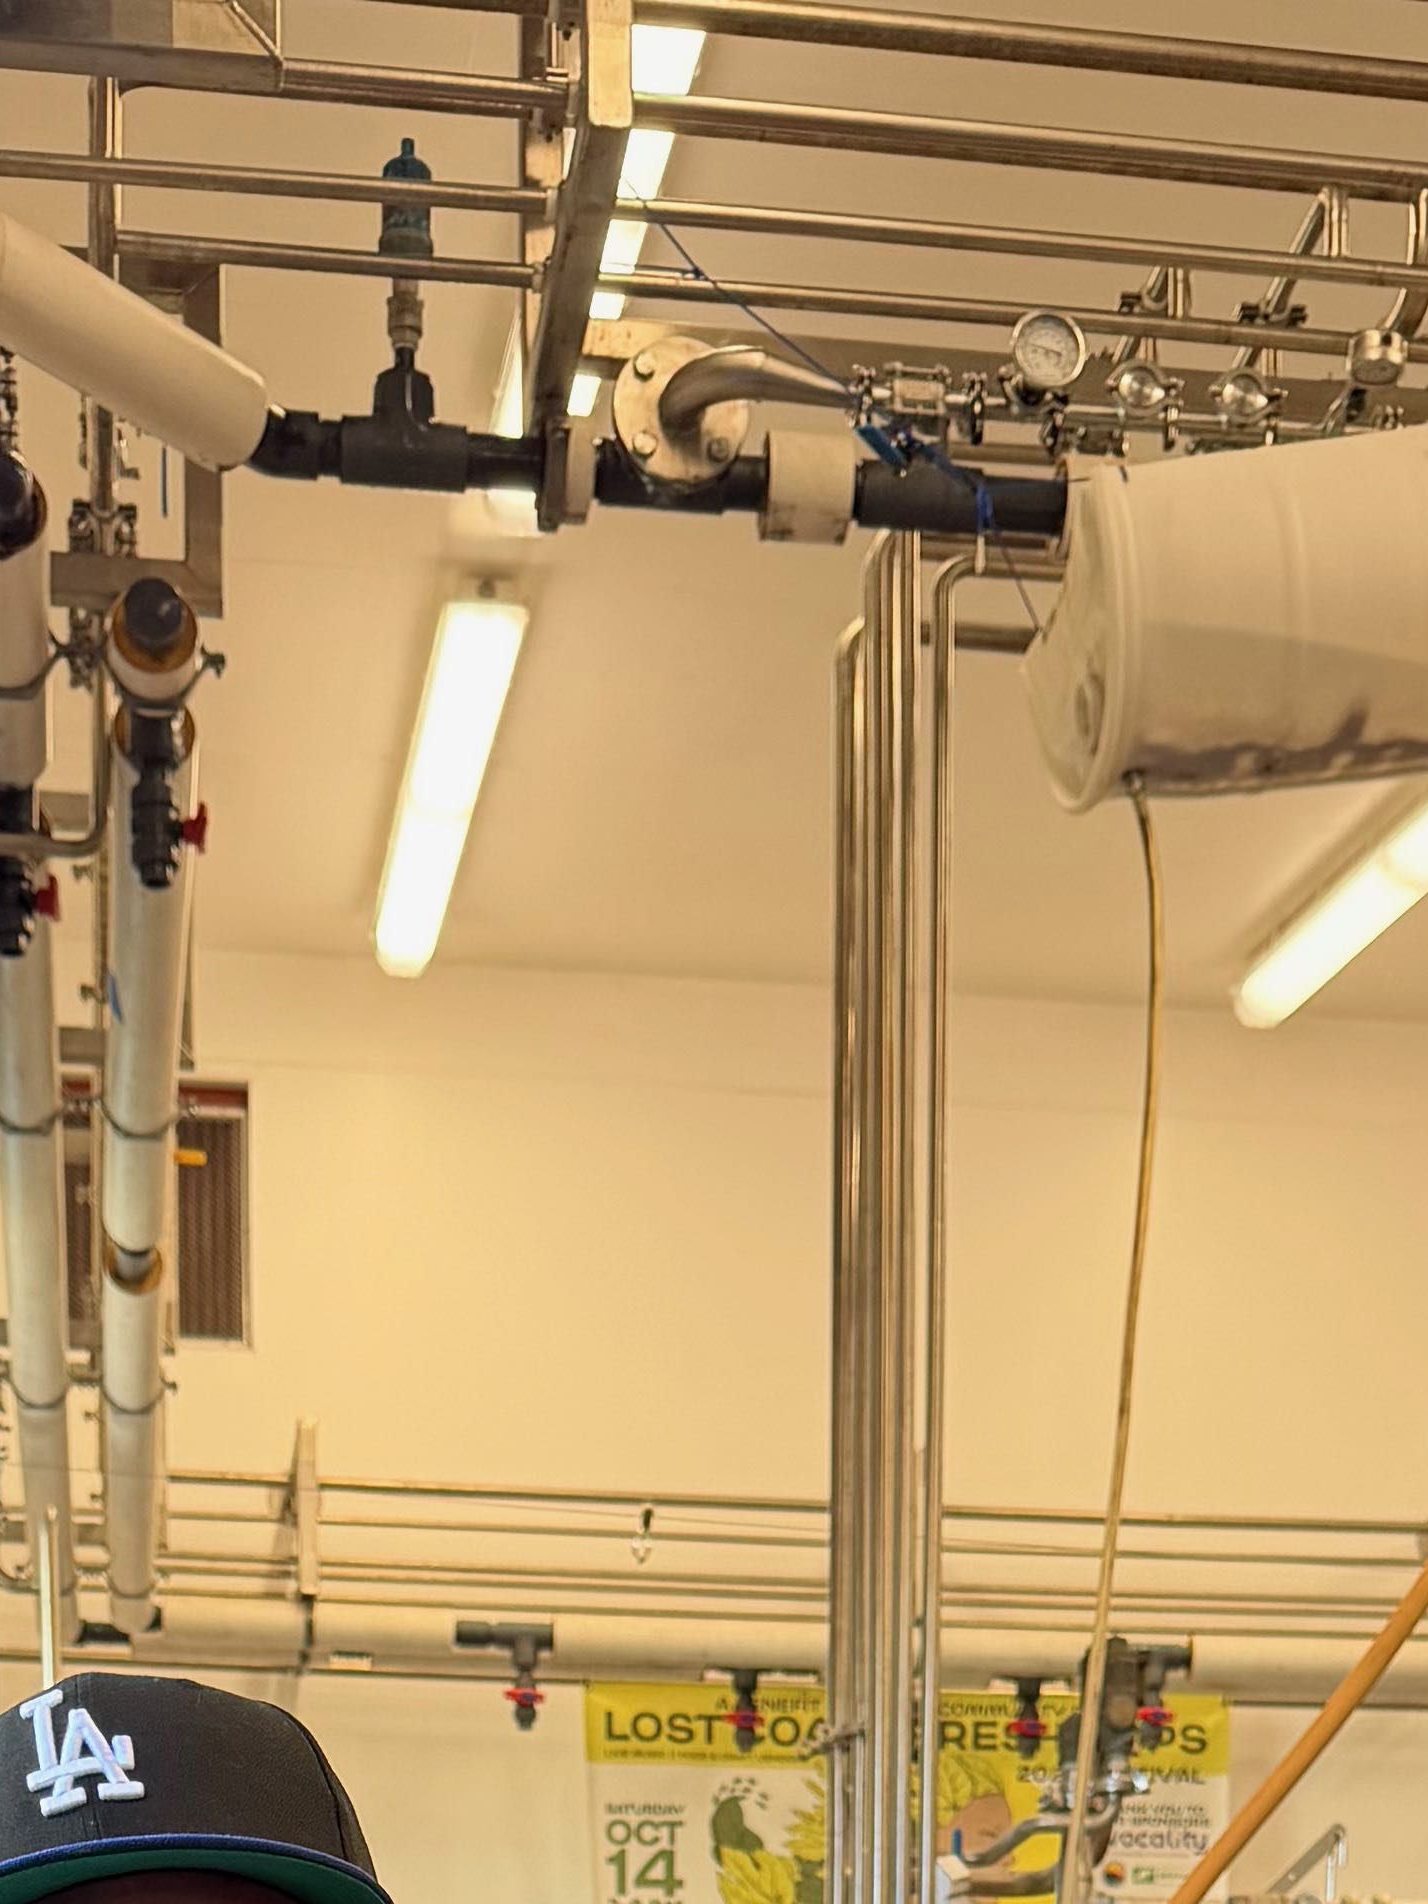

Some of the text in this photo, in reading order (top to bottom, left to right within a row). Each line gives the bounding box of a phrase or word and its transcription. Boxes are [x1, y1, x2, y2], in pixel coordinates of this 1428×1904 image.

[604, 1711, 722, 1744] LOST
[20, 1689, 145, 1817] LA
[605, 1819, 684, 1846] OCT
[605, 1849, 683, 1896] 14
